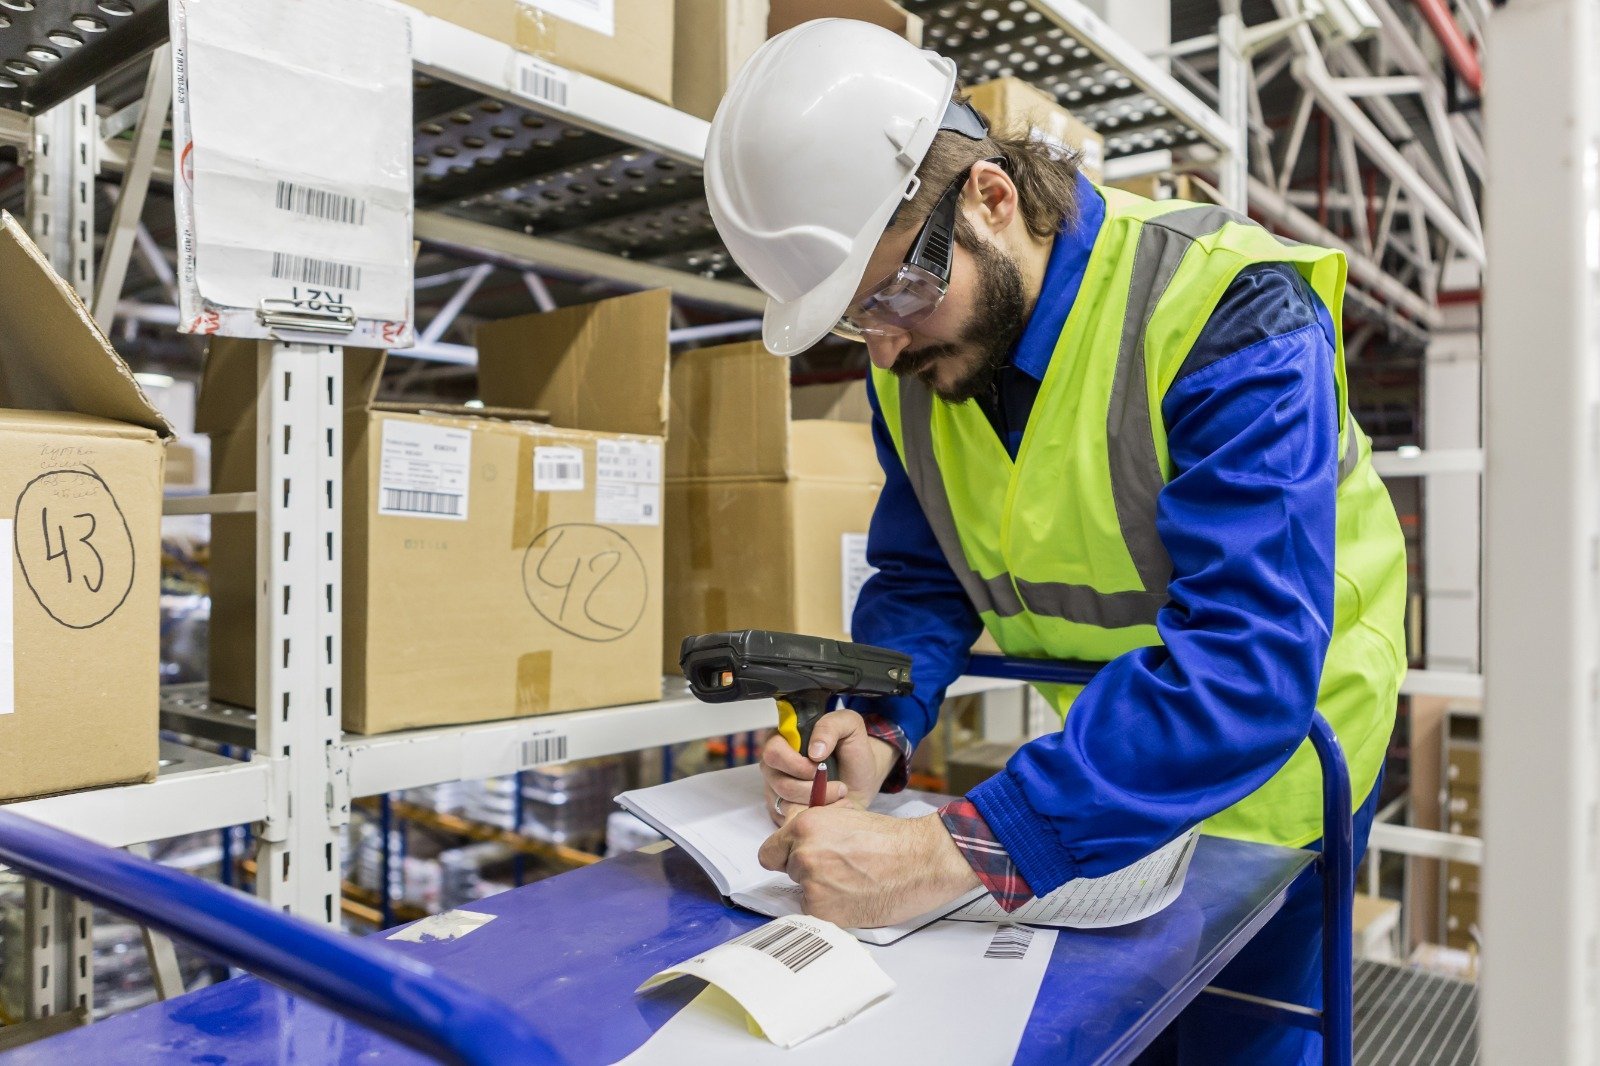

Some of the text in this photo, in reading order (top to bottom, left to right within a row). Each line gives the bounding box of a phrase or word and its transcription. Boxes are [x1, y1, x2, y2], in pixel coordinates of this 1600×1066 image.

[293, 287, 343, 313] R21
[42, 506, 104, 593] 43
[537, 529, 623, 632] 42
